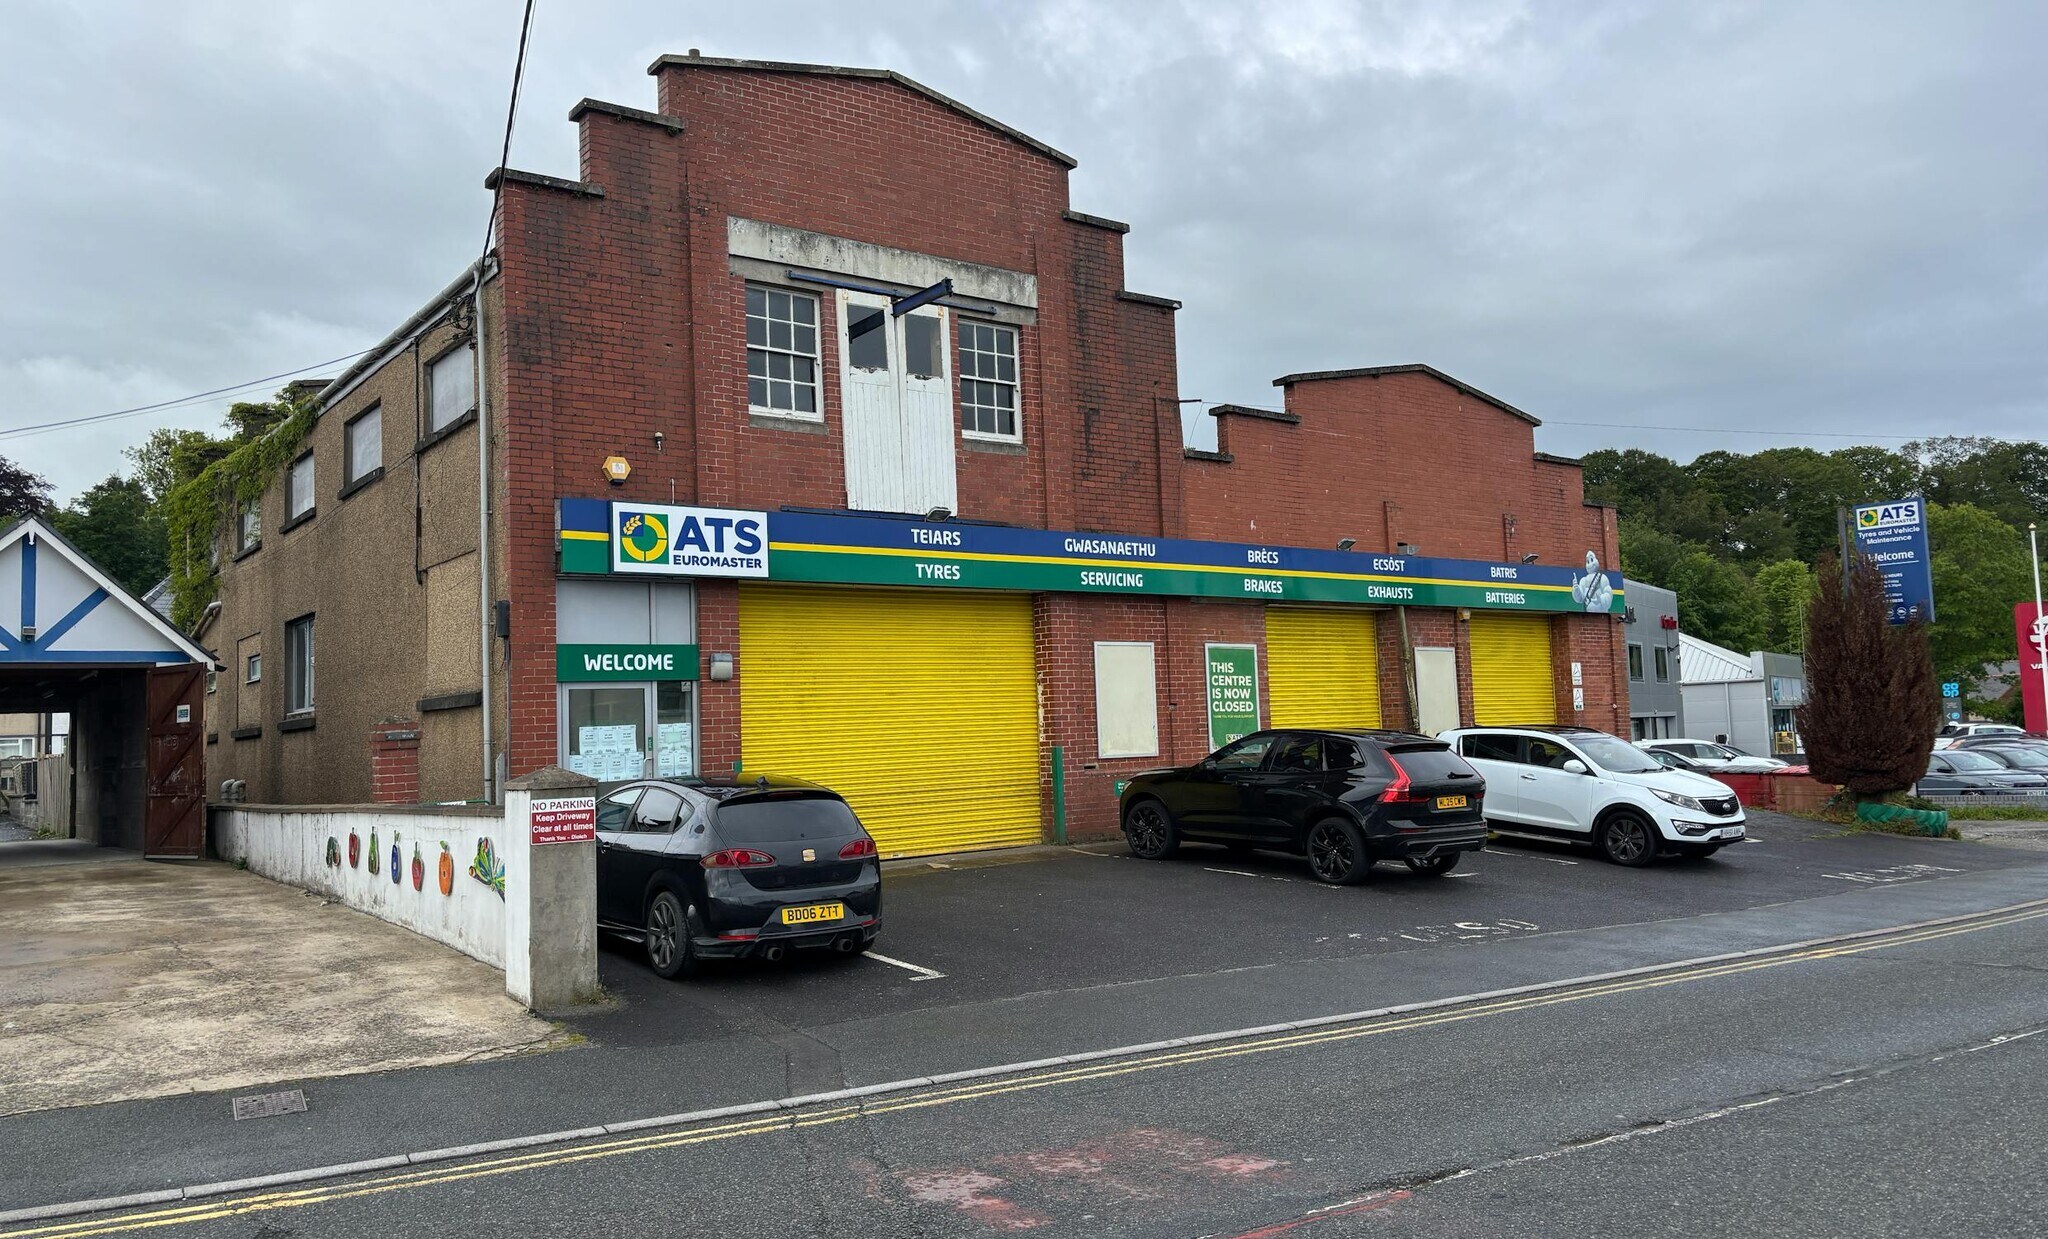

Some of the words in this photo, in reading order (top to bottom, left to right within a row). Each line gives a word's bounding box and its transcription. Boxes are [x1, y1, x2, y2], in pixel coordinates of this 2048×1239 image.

[1880, 505, 1915, 520] ATS
[673, 515, 762, 555] ATS
[911, 528, 961, 546] TEIARS
[1858, 531, 1877, 539] Tyres
[1893, 526, 1920, 534] Vehicle
[1867, 535, 1912, 544] Maintenance
[1064, 538, 1156, 557] GWASANAETHU
[673, 554, 762, 569] EUROMASTER
[1247, 547, 1279, 564] BRÊCS
[915, 563, 960, 580] TYRES
[1490, 566, 1517, 579] BATRIS
[1080, 571, 1143, 588] SERVICING
[1244, 578, 1283, 594] BRAKES
[1367, 585, 1413, 600] EXHAUSTS
[1485, 591, 1525, 605] BATTERIES
[583, 654, 673, 671] WELCOME
[1211, 662, 1234, 673] THIS
[1212, 675, 1252, 686] CENTRE
[1212, 688, 1221, 699] IS
[1224, 688, 1250, 699] NOW
[1212, 701, 1254, 712] CLOSED
[532, 802, 546, 811] NO
[550, 800, 593, 810] PARKING
[536, 814, 555, 823] Keep
[557, 812, 590, 821] Driveway
[533, 825, 552, 833] Clear
[554, 824, 561, 832] at
[563, 823, 571, 831] all
[573, 822, 593, 831] times
[787, 908, 816, 922] BD06
[819, 905, 839, 919] ZTT
